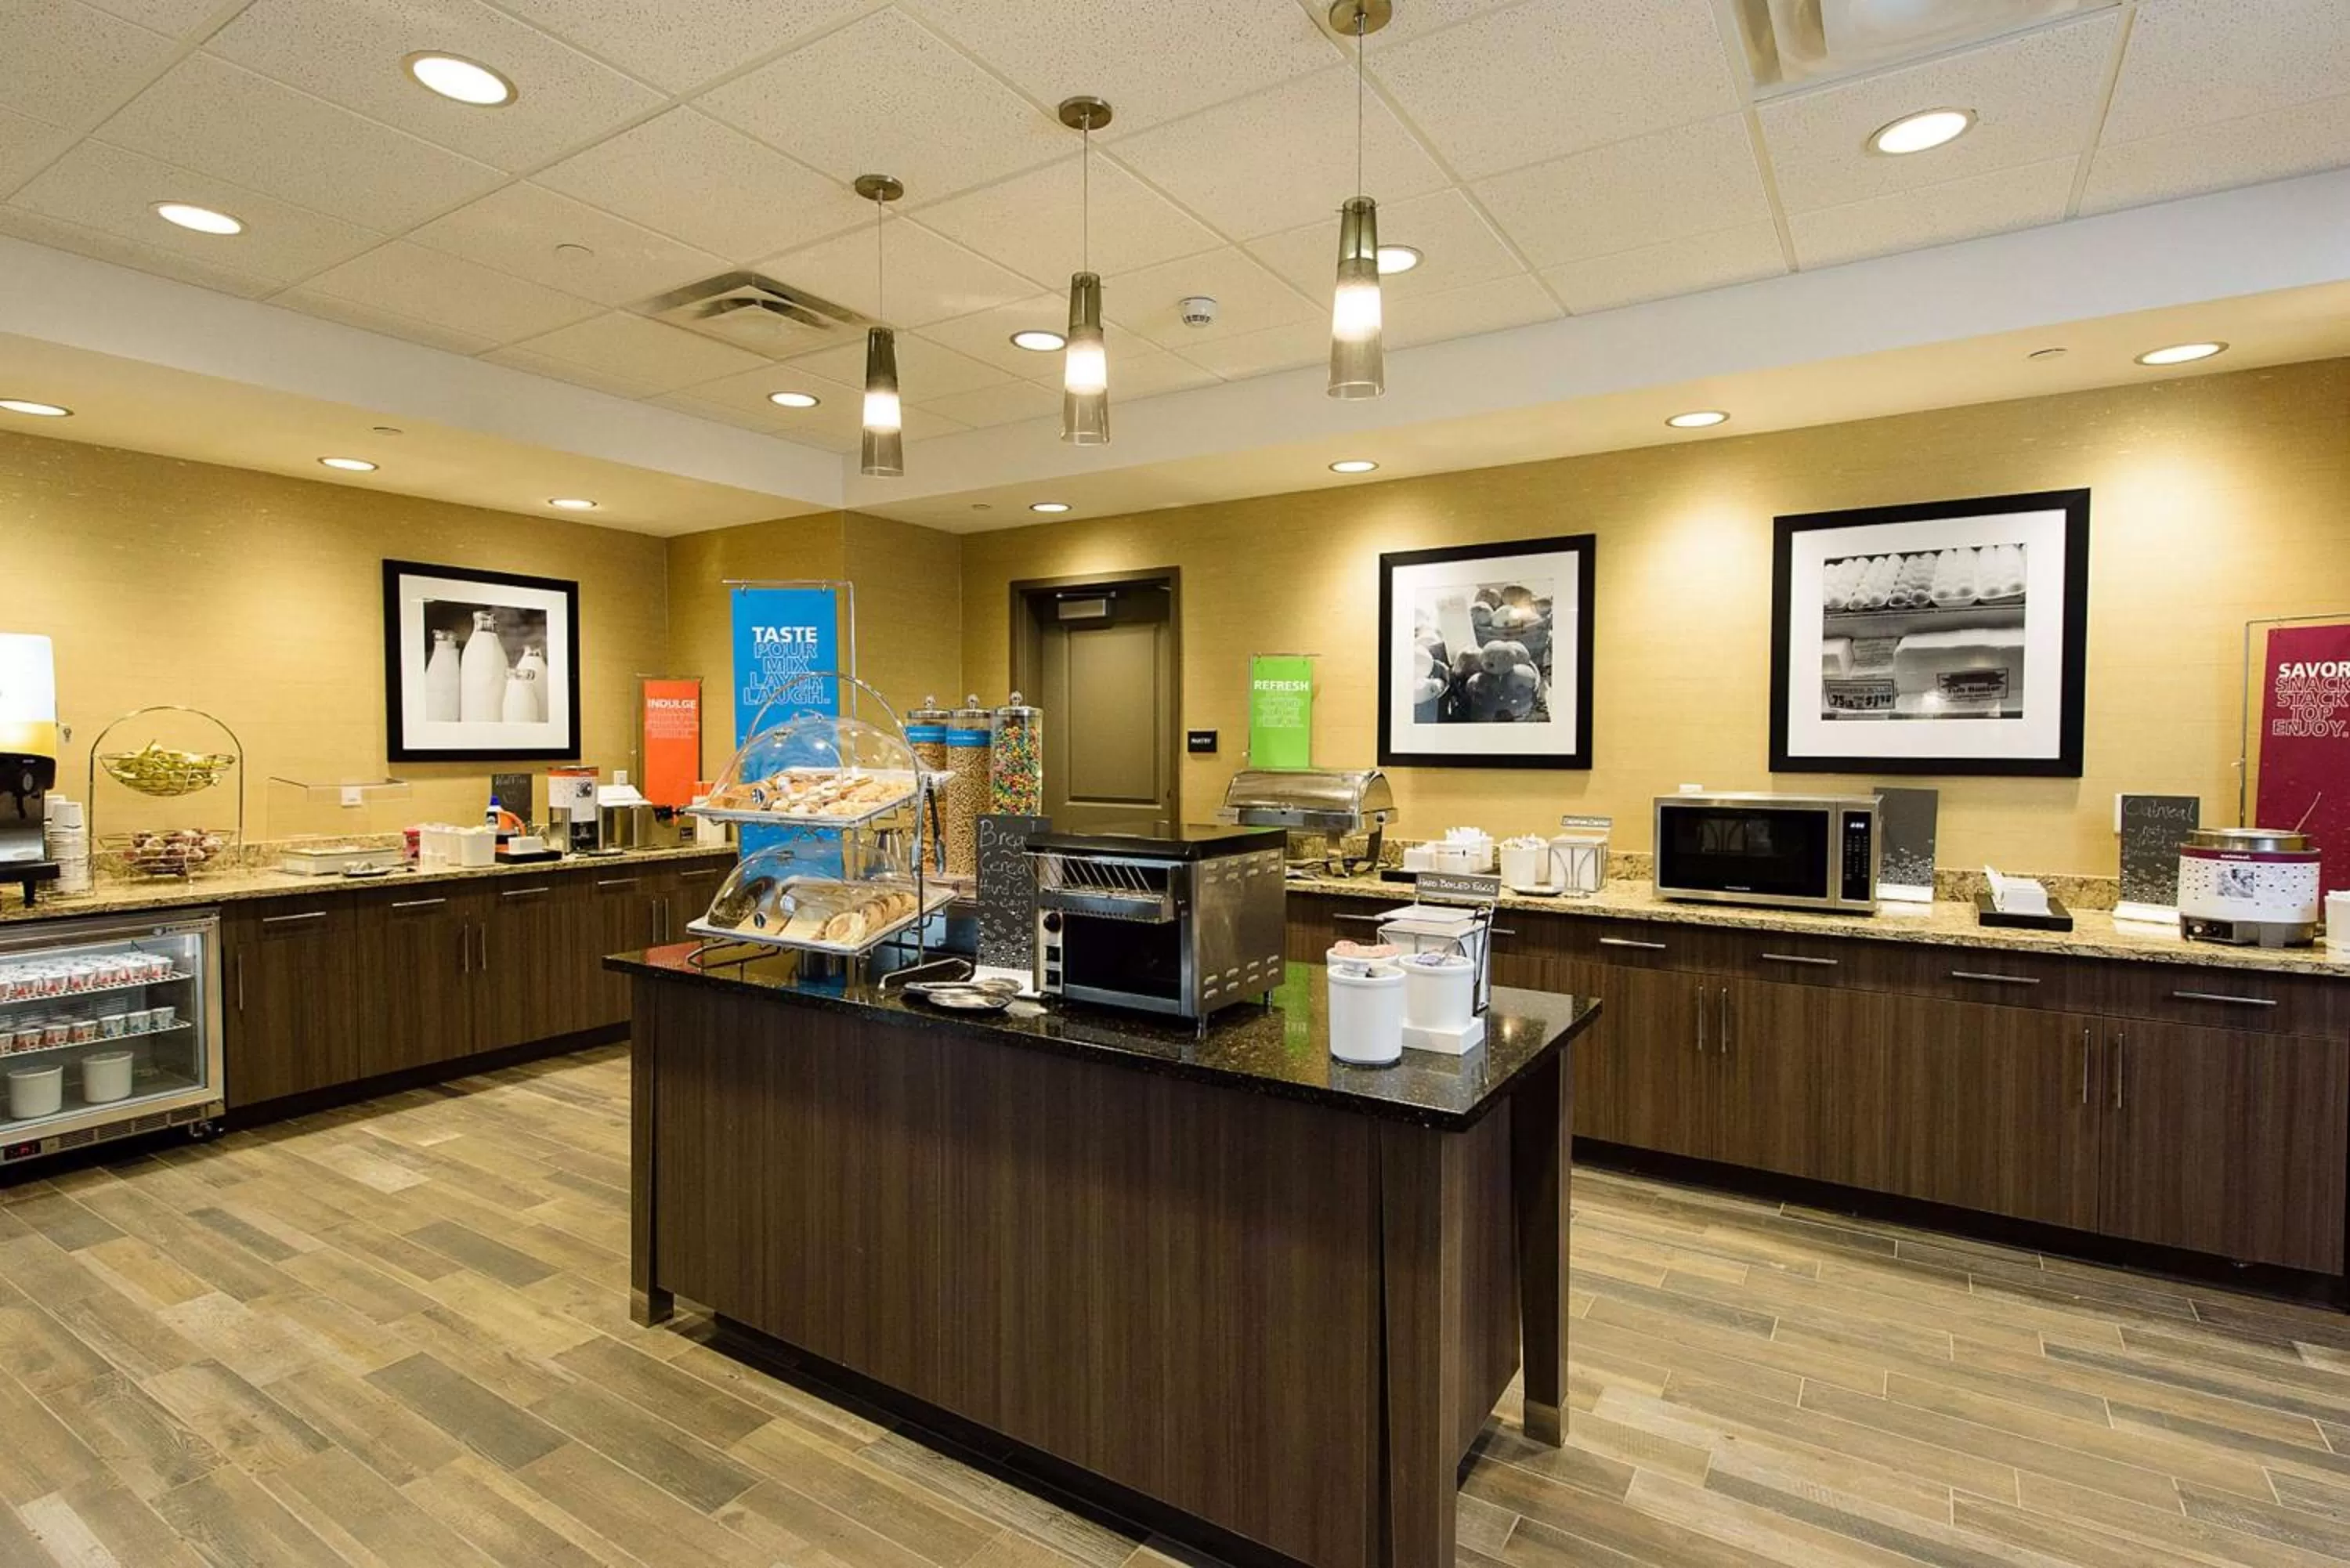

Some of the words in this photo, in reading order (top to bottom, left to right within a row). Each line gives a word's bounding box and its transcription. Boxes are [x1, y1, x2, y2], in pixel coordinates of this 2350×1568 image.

[752, 626, 818, 642] TASTE
[754, 642, 818, 658] POUR
[763, 657, 809, 673] MIX
[2279, 661, 2350, 677] SAVOR
[1253, 680, 1309, 691] REFRESH
[2275, 677, 2350, 692] SNACK
[648, 698, 696, 709] INDULGE
[2277, 692, 2350, 707] STACK
[2290, 706, 2334, 721] TOP
[2272, 720, 2349, 737] ENJOY.
